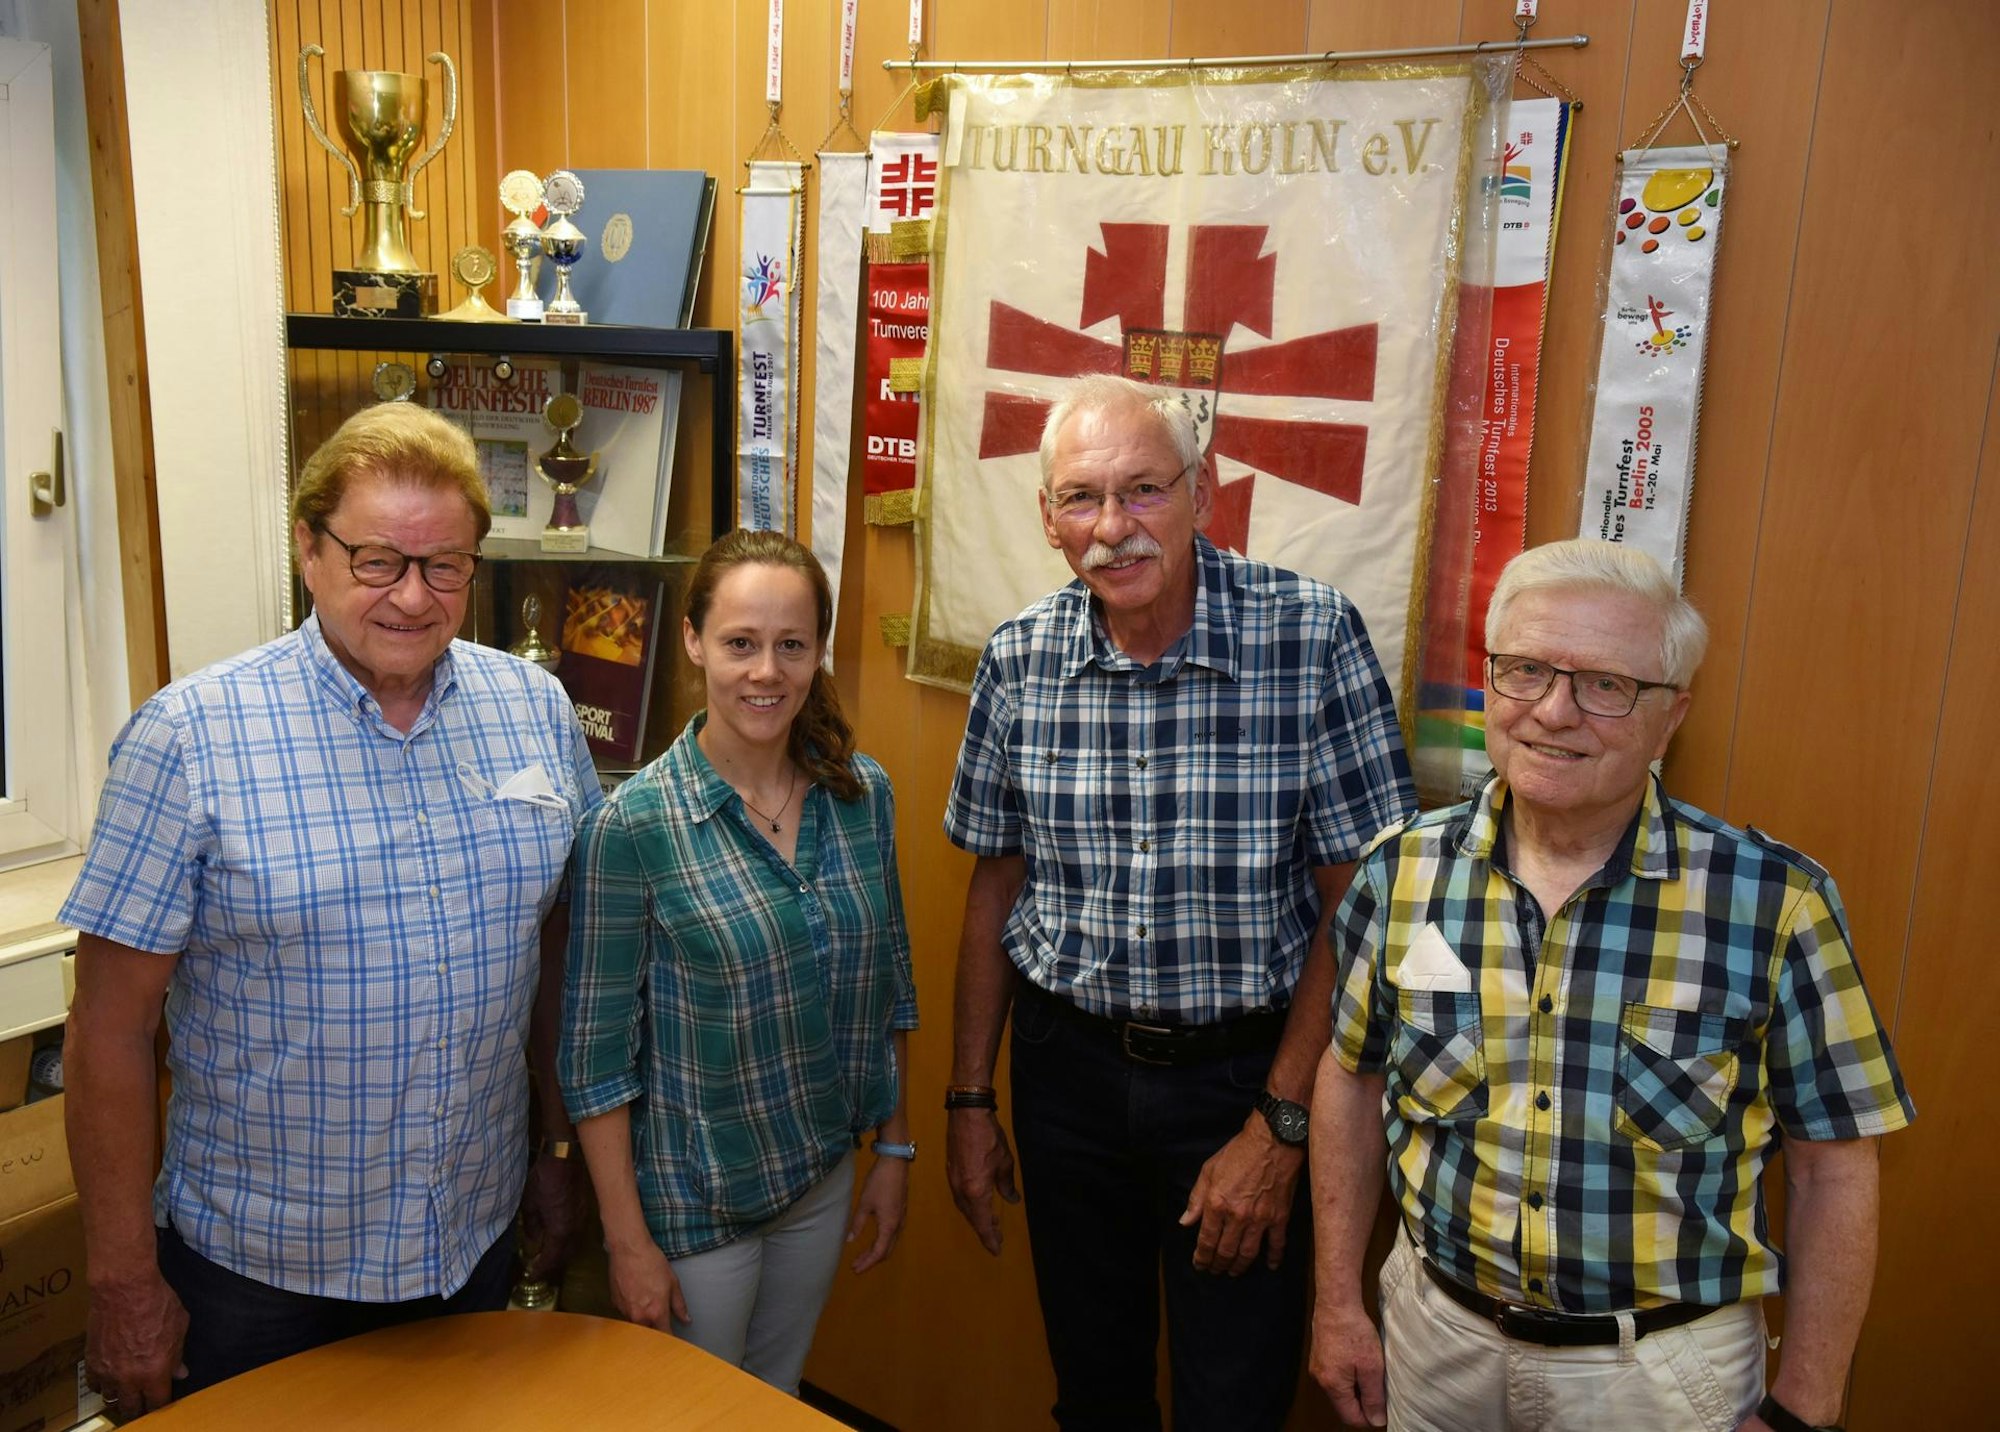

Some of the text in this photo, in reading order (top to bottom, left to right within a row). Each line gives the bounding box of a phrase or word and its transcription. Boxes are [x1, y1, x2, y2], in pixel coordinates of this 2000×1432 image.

[1689, 0, 1704, 46] Jugendol
[967, 122, 1186, 177] TURNGAU
[1361, 117, 1442, 176] e.V.
[873, 290, 898, 309] 100
[582, 386, 658, 416] BERLIN 1987
[584, 370, 658, 393] Deutsches Turnfest
[752, 350, 768, 439] TURNFEST
[1506, 363, 1521, 437] Internationales
[867, 435, 916, 457] DTB
[1484, 337, 1510, 512] Deutsches Turnfest 2013
[1628, 405, 1655, 510] Berlin 2005
[1652, 444, 1662, 467] Mai
[759, 447, 771, 532] DEUTSCHES
[1601, 489, 1613, 540] ationales
[1609, 438, 1635, 543] hes Turnfest
[575, 703, 612, 726] SPORT
